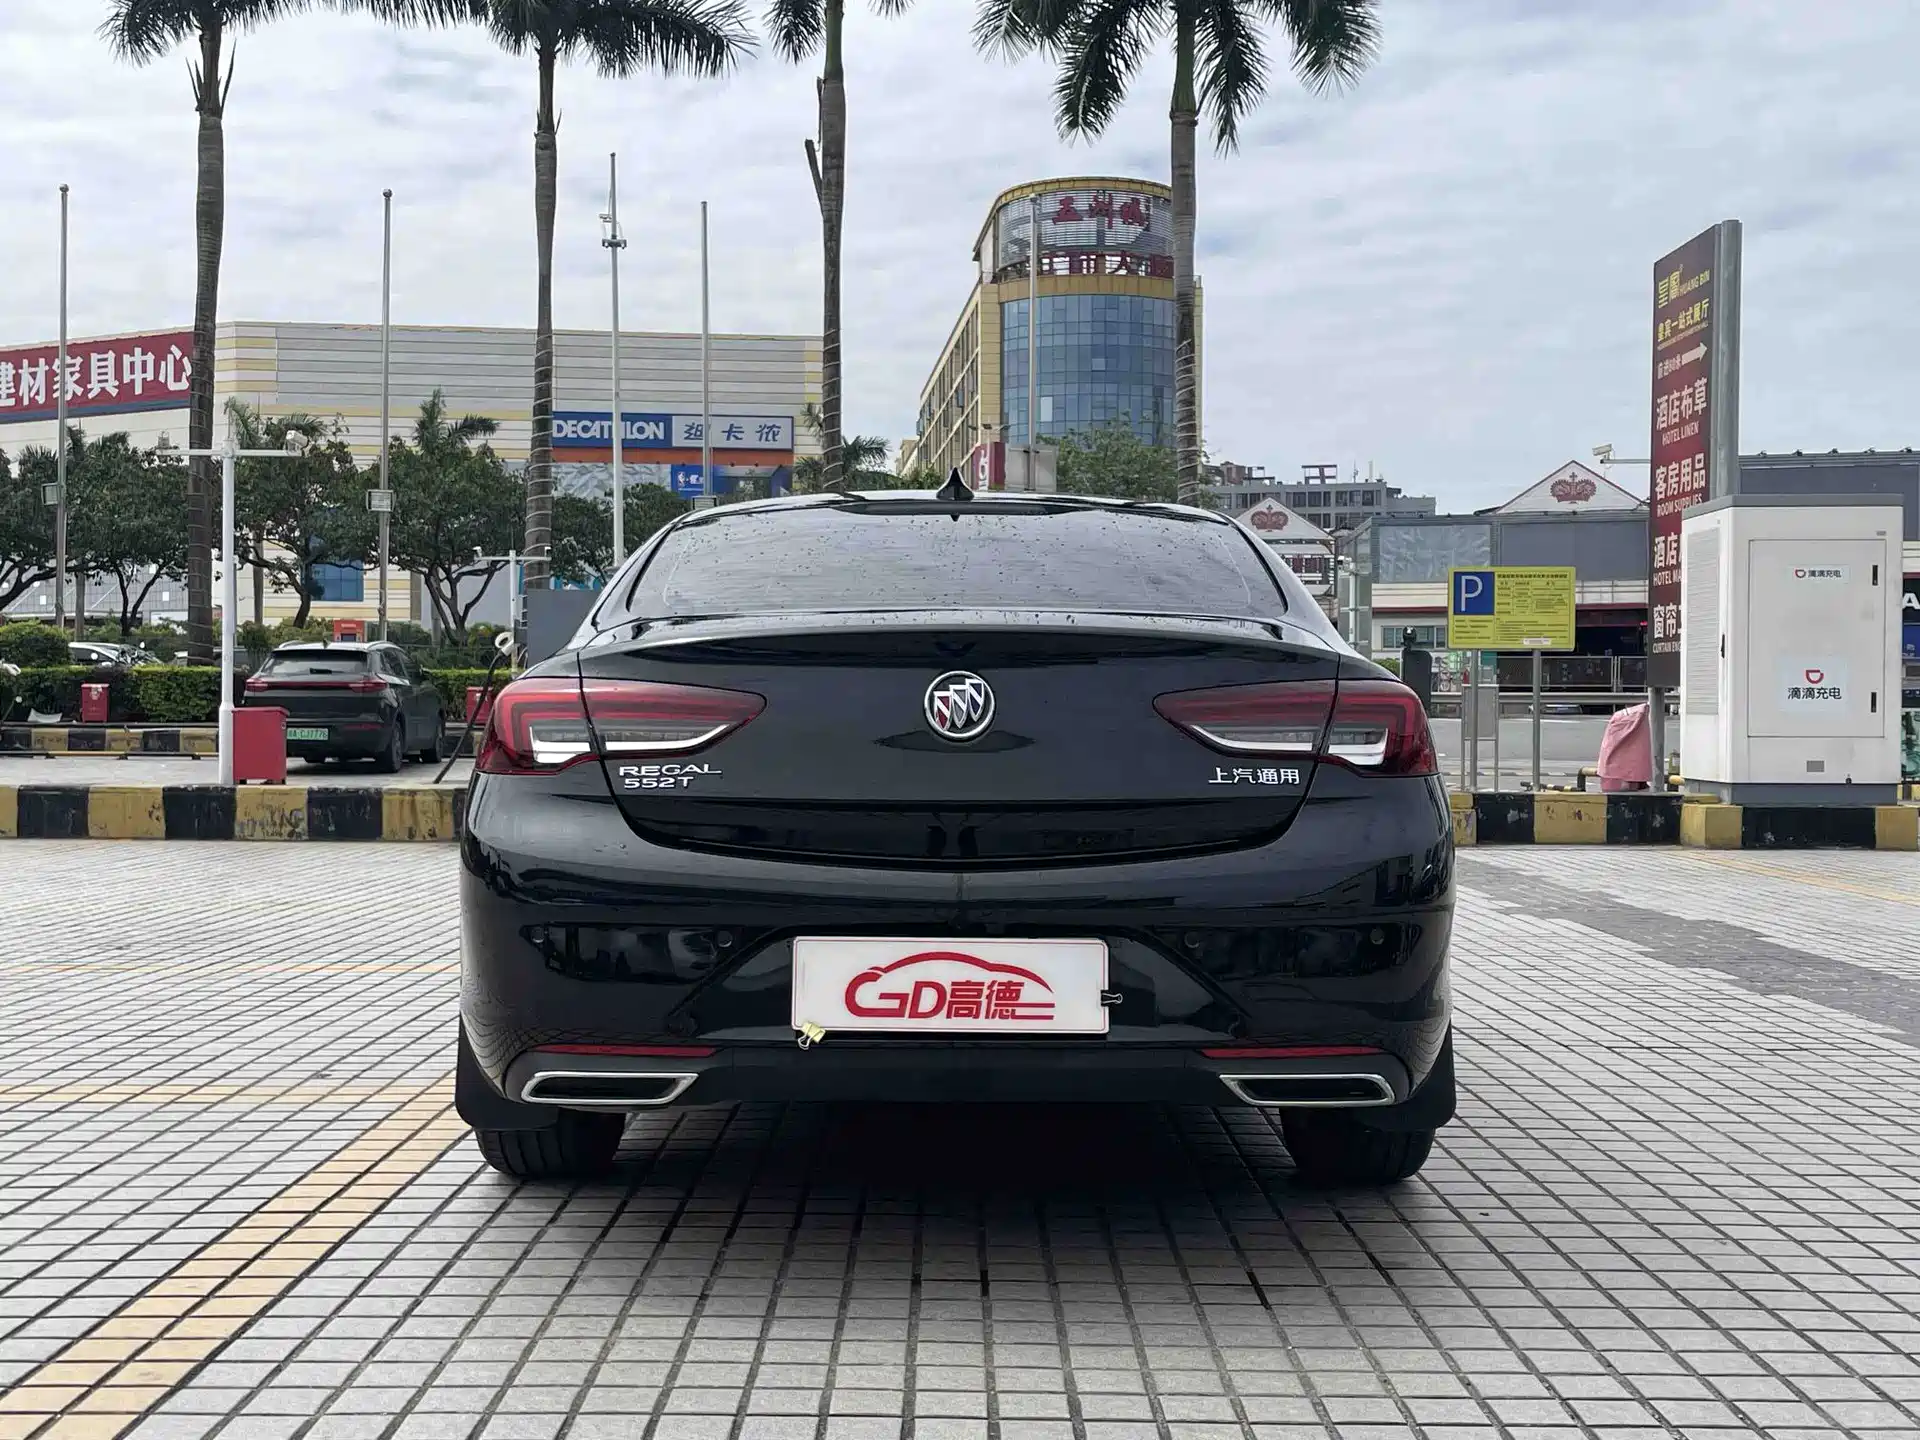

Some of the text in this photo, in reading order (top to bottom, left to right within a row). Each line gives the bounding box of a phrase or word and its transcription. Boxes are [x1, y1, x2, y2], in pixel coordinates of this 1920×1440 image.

[1656, 377, 1707, 431] 酒店布草
[1662, 420, 1699, 446] HOTEL LINEN
[1655, 453, 1706, 501] 客房用品
[1657, 501, 1674, 517] ROOM
[1653, 571, 1672, 587] HOTEL
[1808, 569, 1842, 578] 滴滴充电
[1461, 575, 1483, 612] P
[1787, 686, 1842, 700] 滴滴充电
[619, 763, 722, 776] REGAL
[1208, 767, 1300, 784] 上汽通用
[624, 776, 694, 789] 552T
